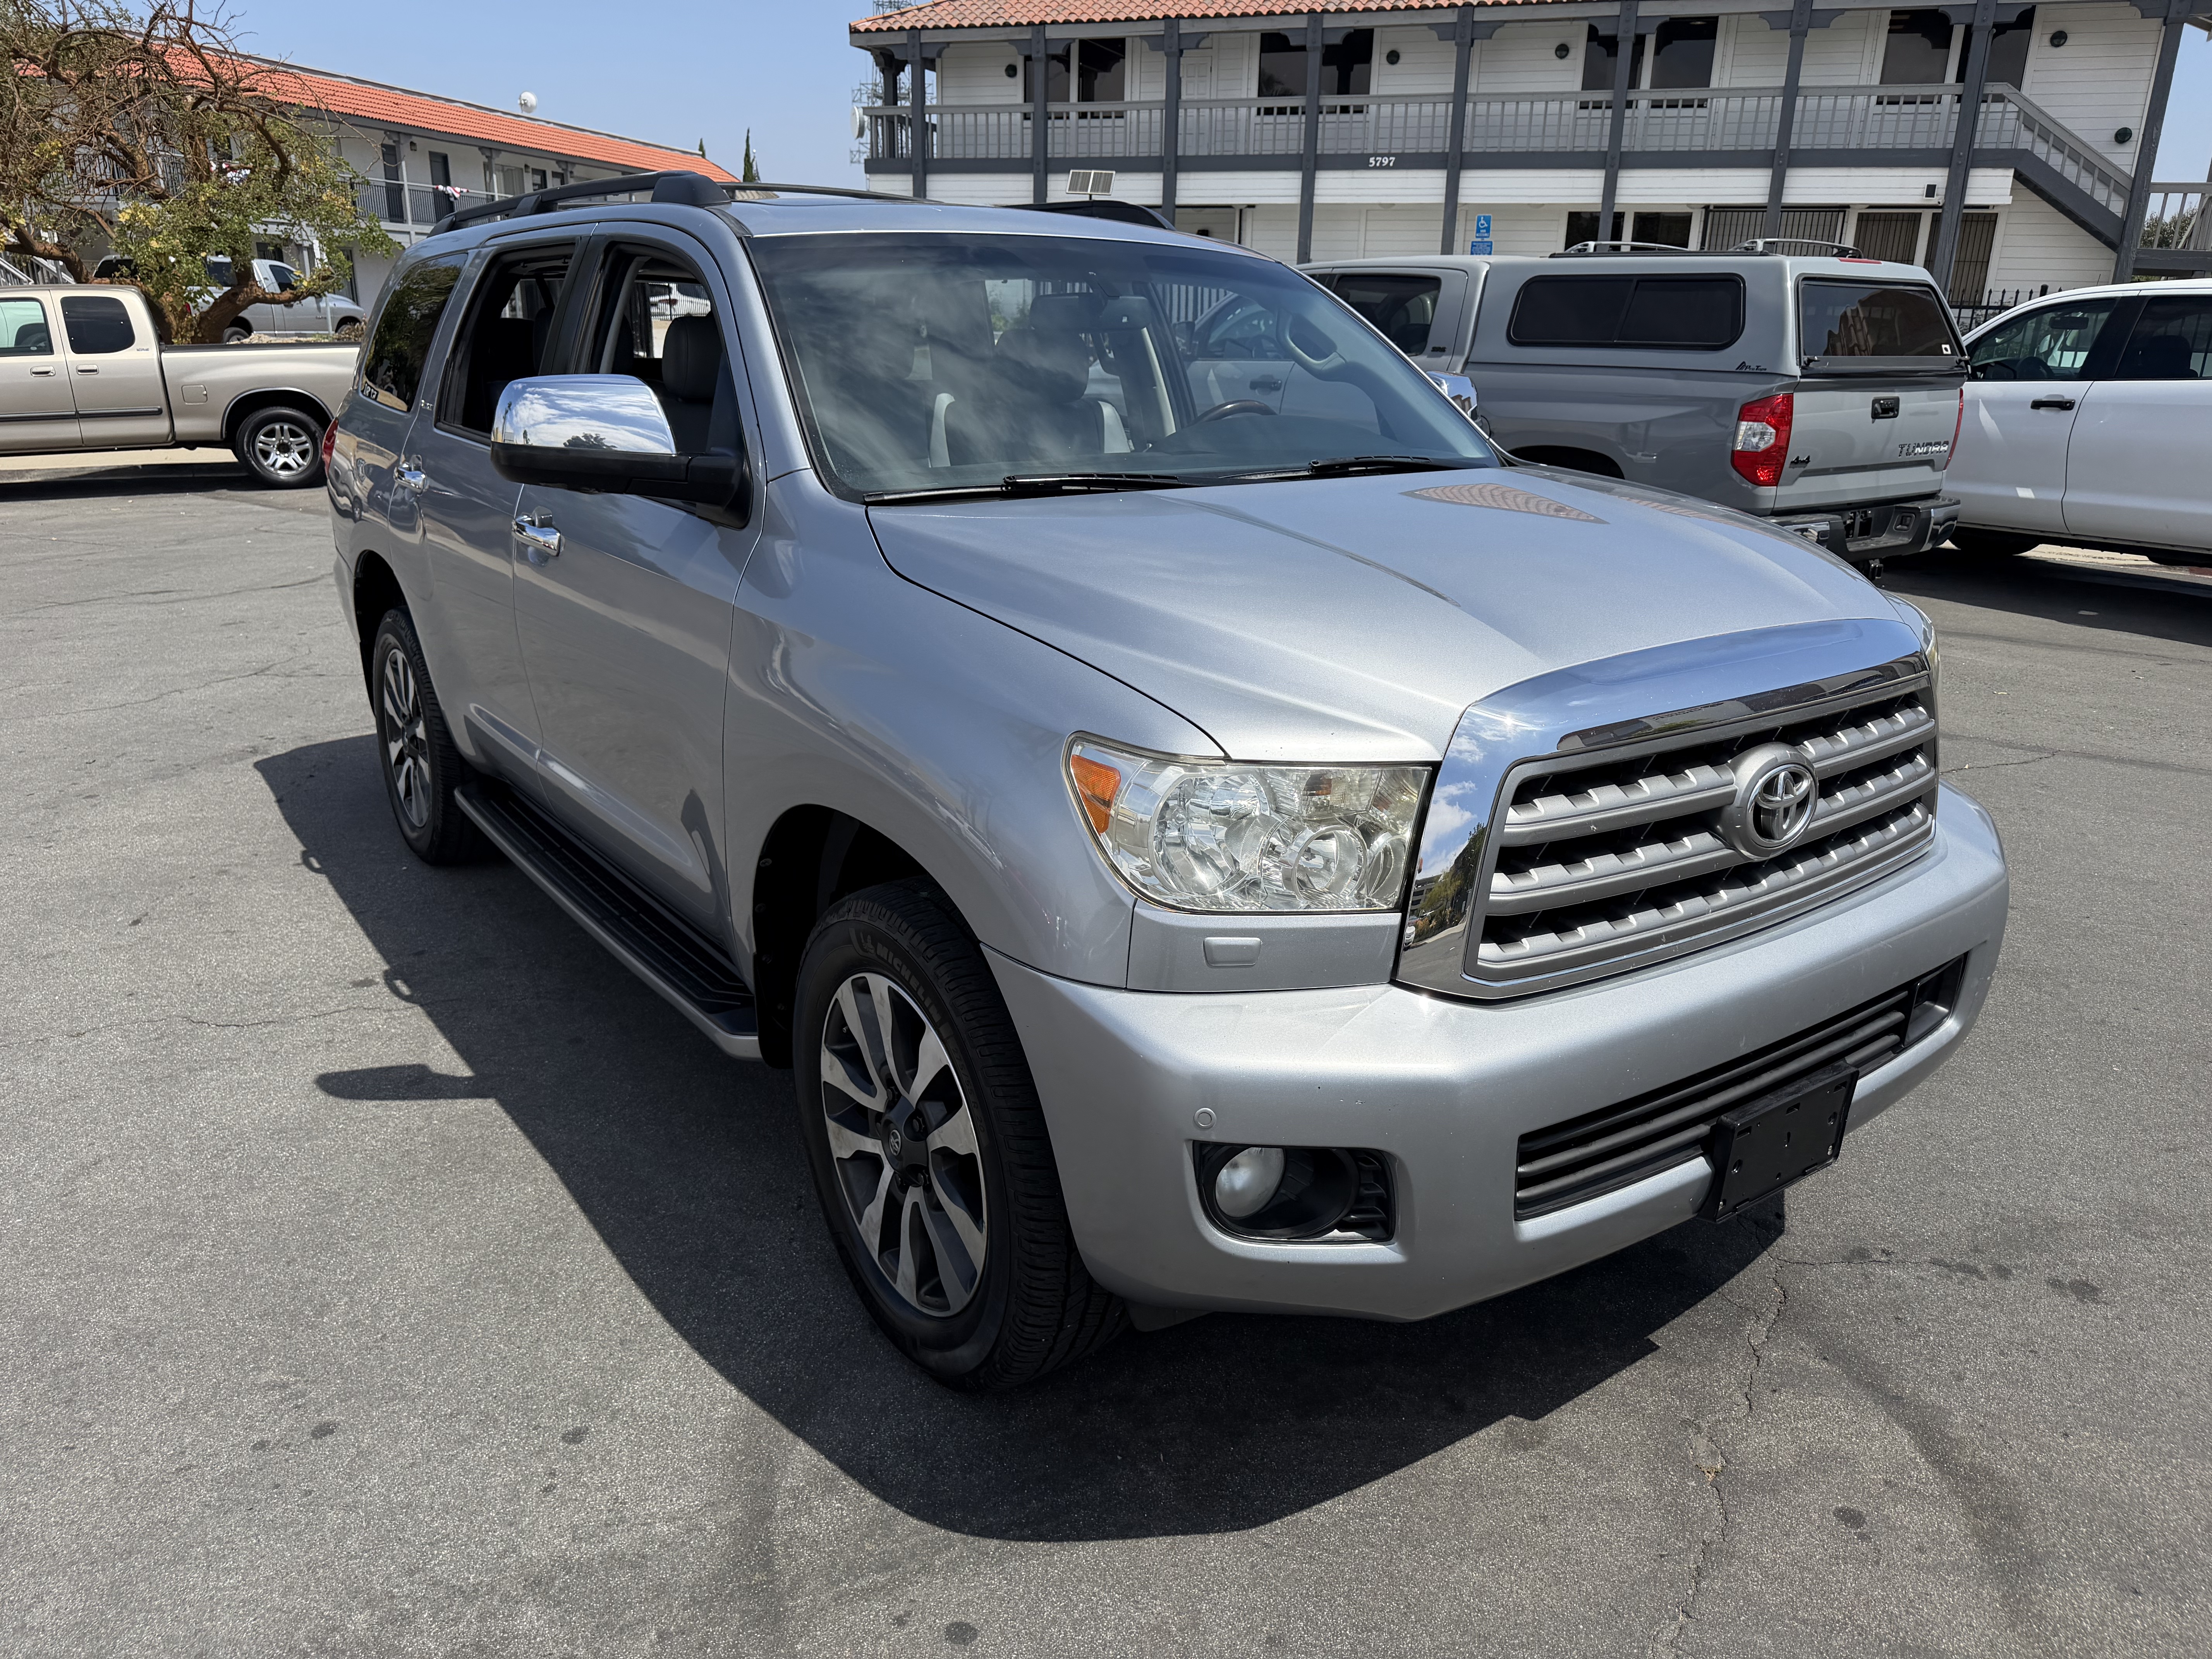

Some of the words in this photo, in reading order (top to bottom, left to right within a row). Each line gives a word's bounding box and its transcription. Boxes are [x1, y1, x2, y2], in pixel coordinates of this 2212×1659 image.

[1369, 156, 1396, 167] 5797
[1898, 441, 1949, 457] TUNDRA
[876, 942, 941, 1022] MICHELIN
[952, 1047, 974, 1095] 275/55
